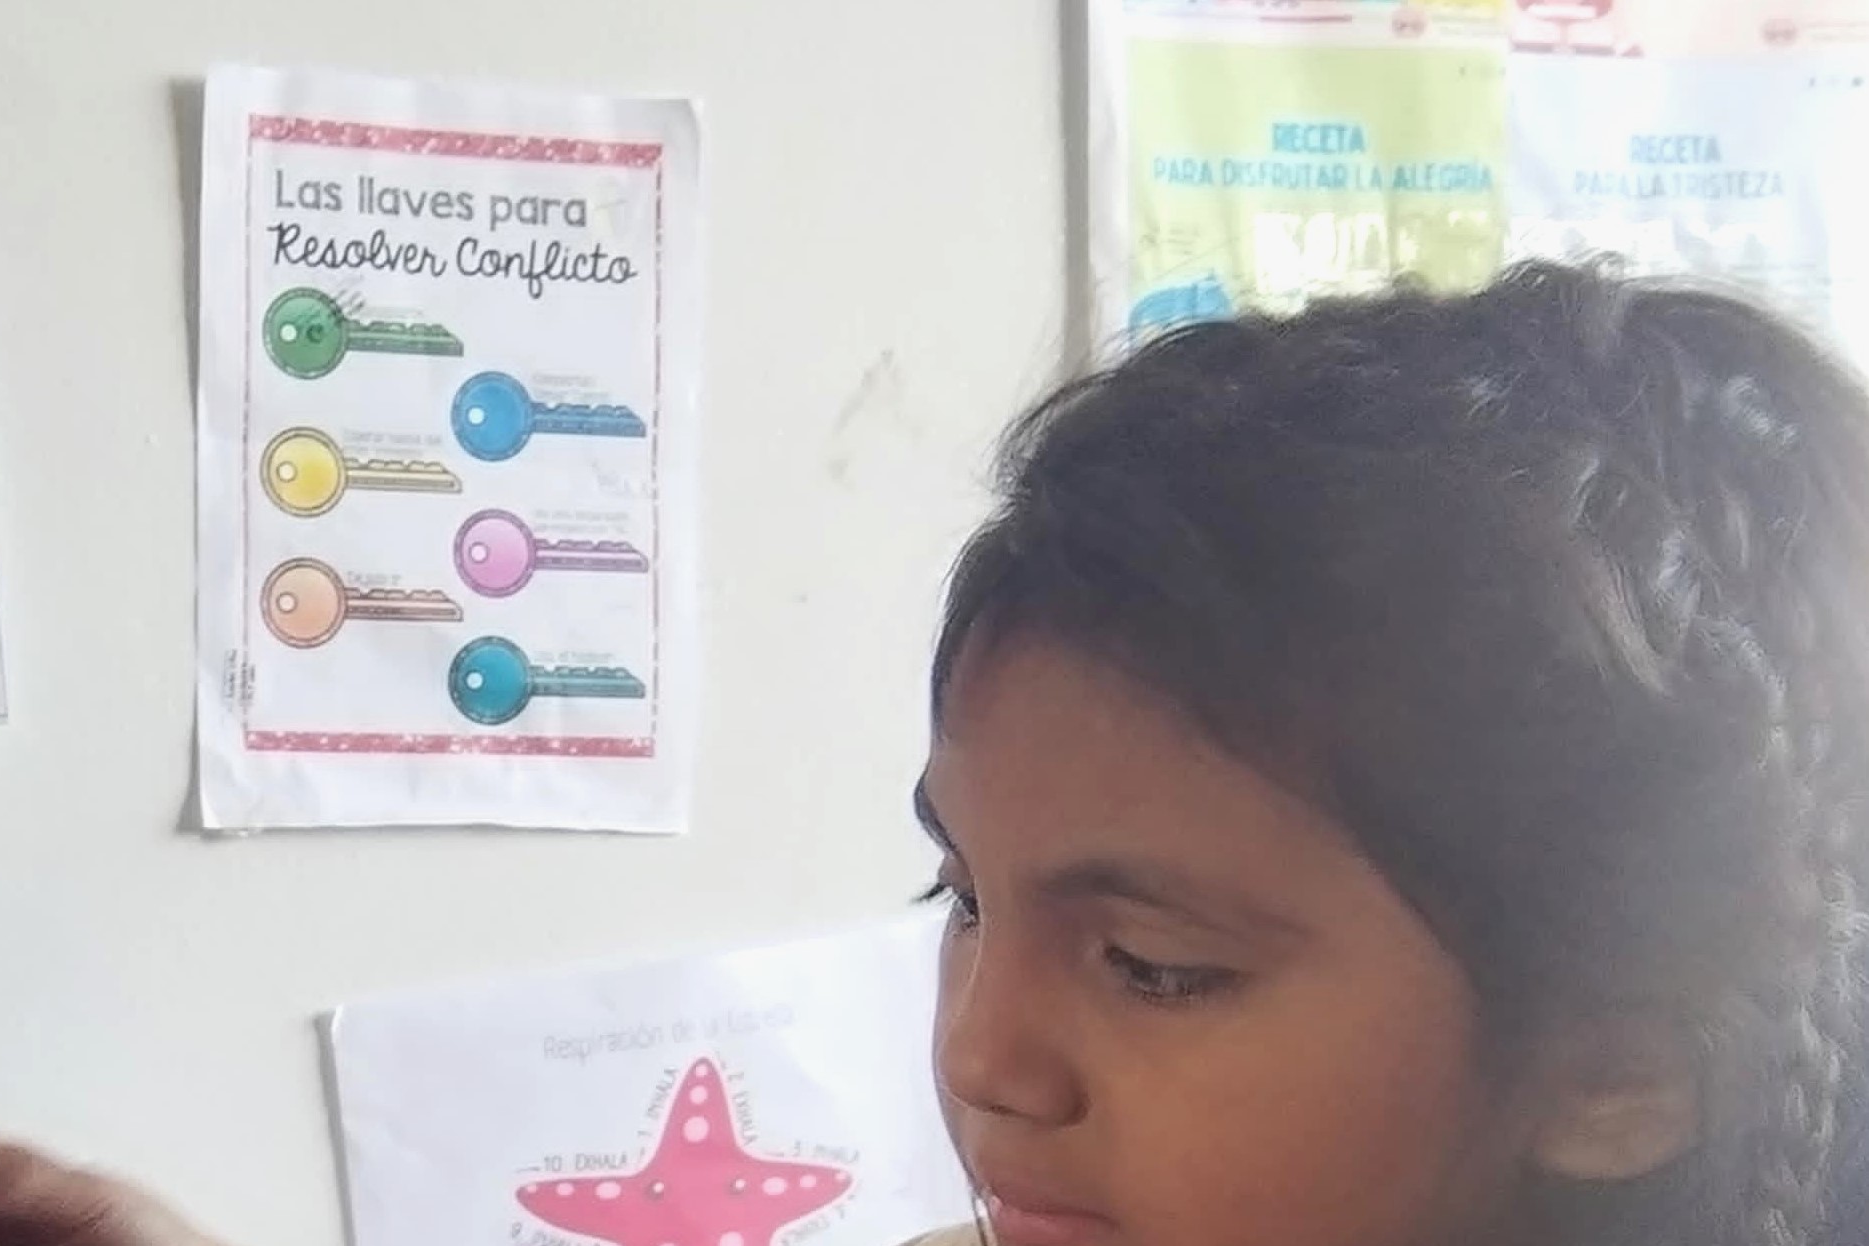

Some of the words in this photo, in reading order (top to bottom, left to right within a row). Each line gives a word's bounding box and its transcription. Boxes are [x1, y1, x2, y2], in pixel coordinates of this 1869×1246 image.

[1271, 122, 1367, 153] RECETA
[1631, 134, 1722, 164] RECETA
[1152, 158, 1213, 186] PARA
[1221, 158, 1350, 190] DISFRUTAR
[1355, 163, 1381, 190] LA
[1574, 170, 1630, 196] PARA
[1635, 172, 1667, 197] LA
[1672, 170, 1785, 199] TRISTEZA
[274, 170, 343, 212] Las
[358, 176, 474, 220] llaves
[489, 194, 587, 231] para
[266, 222, 448, 277] Resolver
[457, 237, 638, 299] Conflicto
[542, 1021, 663, 1067] Respiración
[543, 1154, 563, 1172] 10
[575, 1152, 627, 1172] EXHALA
